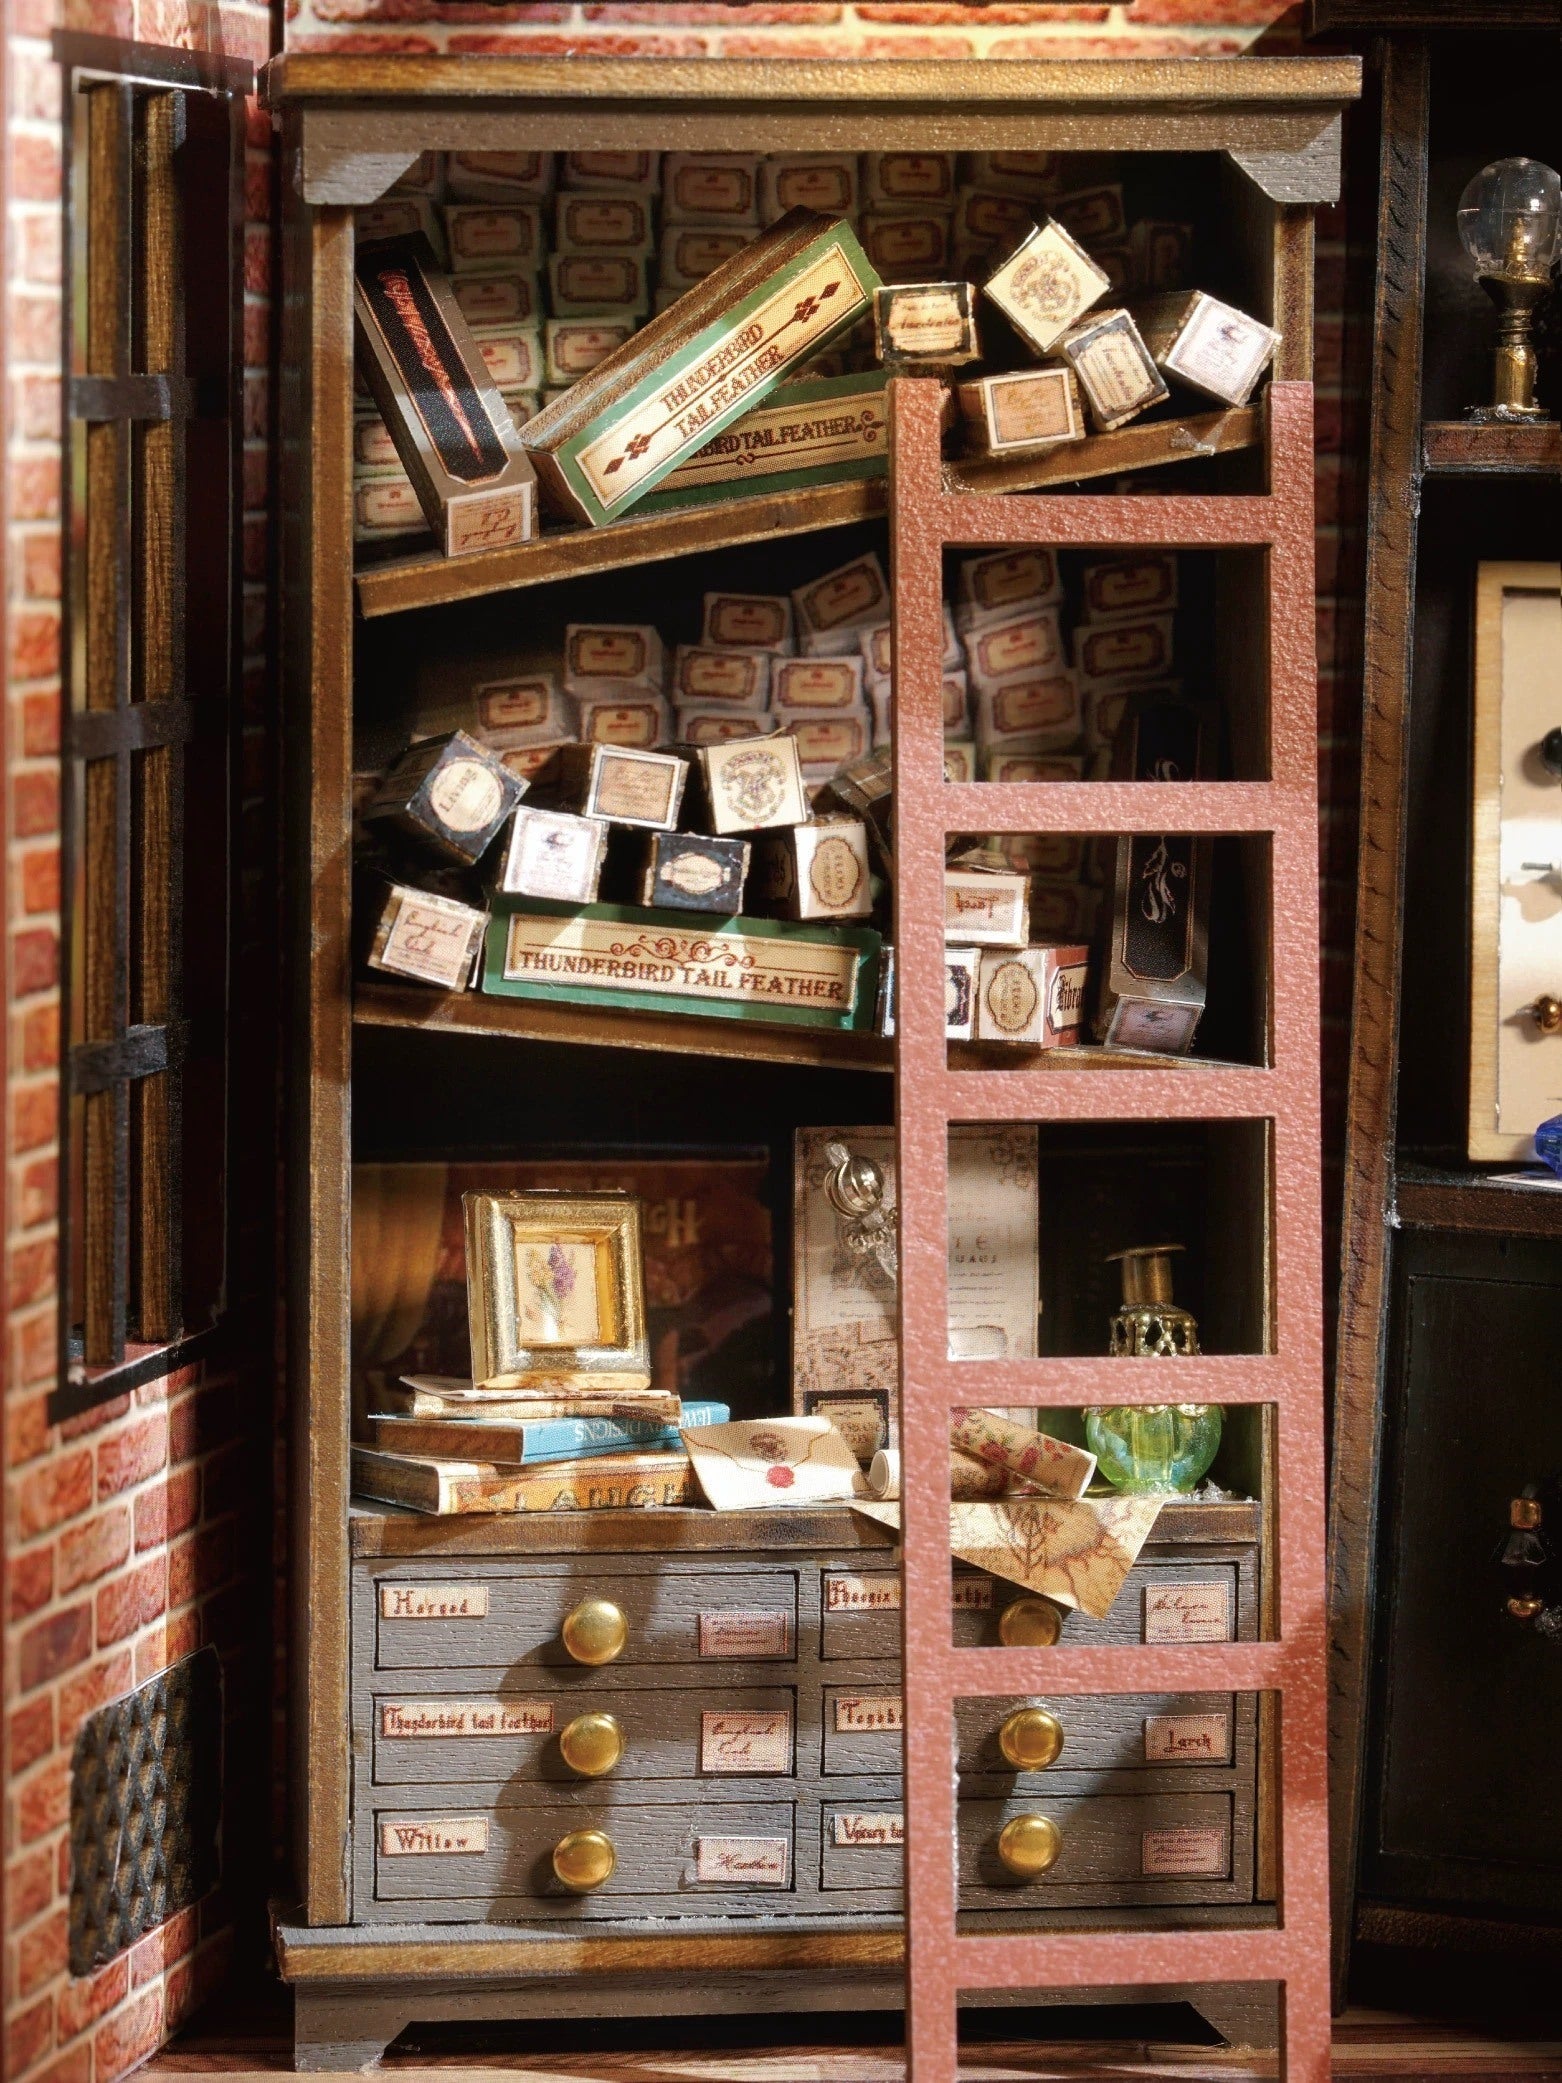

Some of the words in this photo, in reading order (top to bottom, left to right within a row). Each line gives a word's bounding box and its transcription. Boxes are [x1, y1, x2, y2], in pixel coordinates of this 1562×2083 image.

[661, 323, 764, 413] THUNDERBIRD
[674, 402, 712, 438] TAIL
[710, 344, 785, 413] FEATHER
[739, 428, 780, 450] TAIL
[779, 415, 860, 443] FEATHER
[519, 951, 675, 983] THUNDERBIRD
[680, 965, 733, 988] TAIL
[739, 975, 845, 1001] FEATHER
